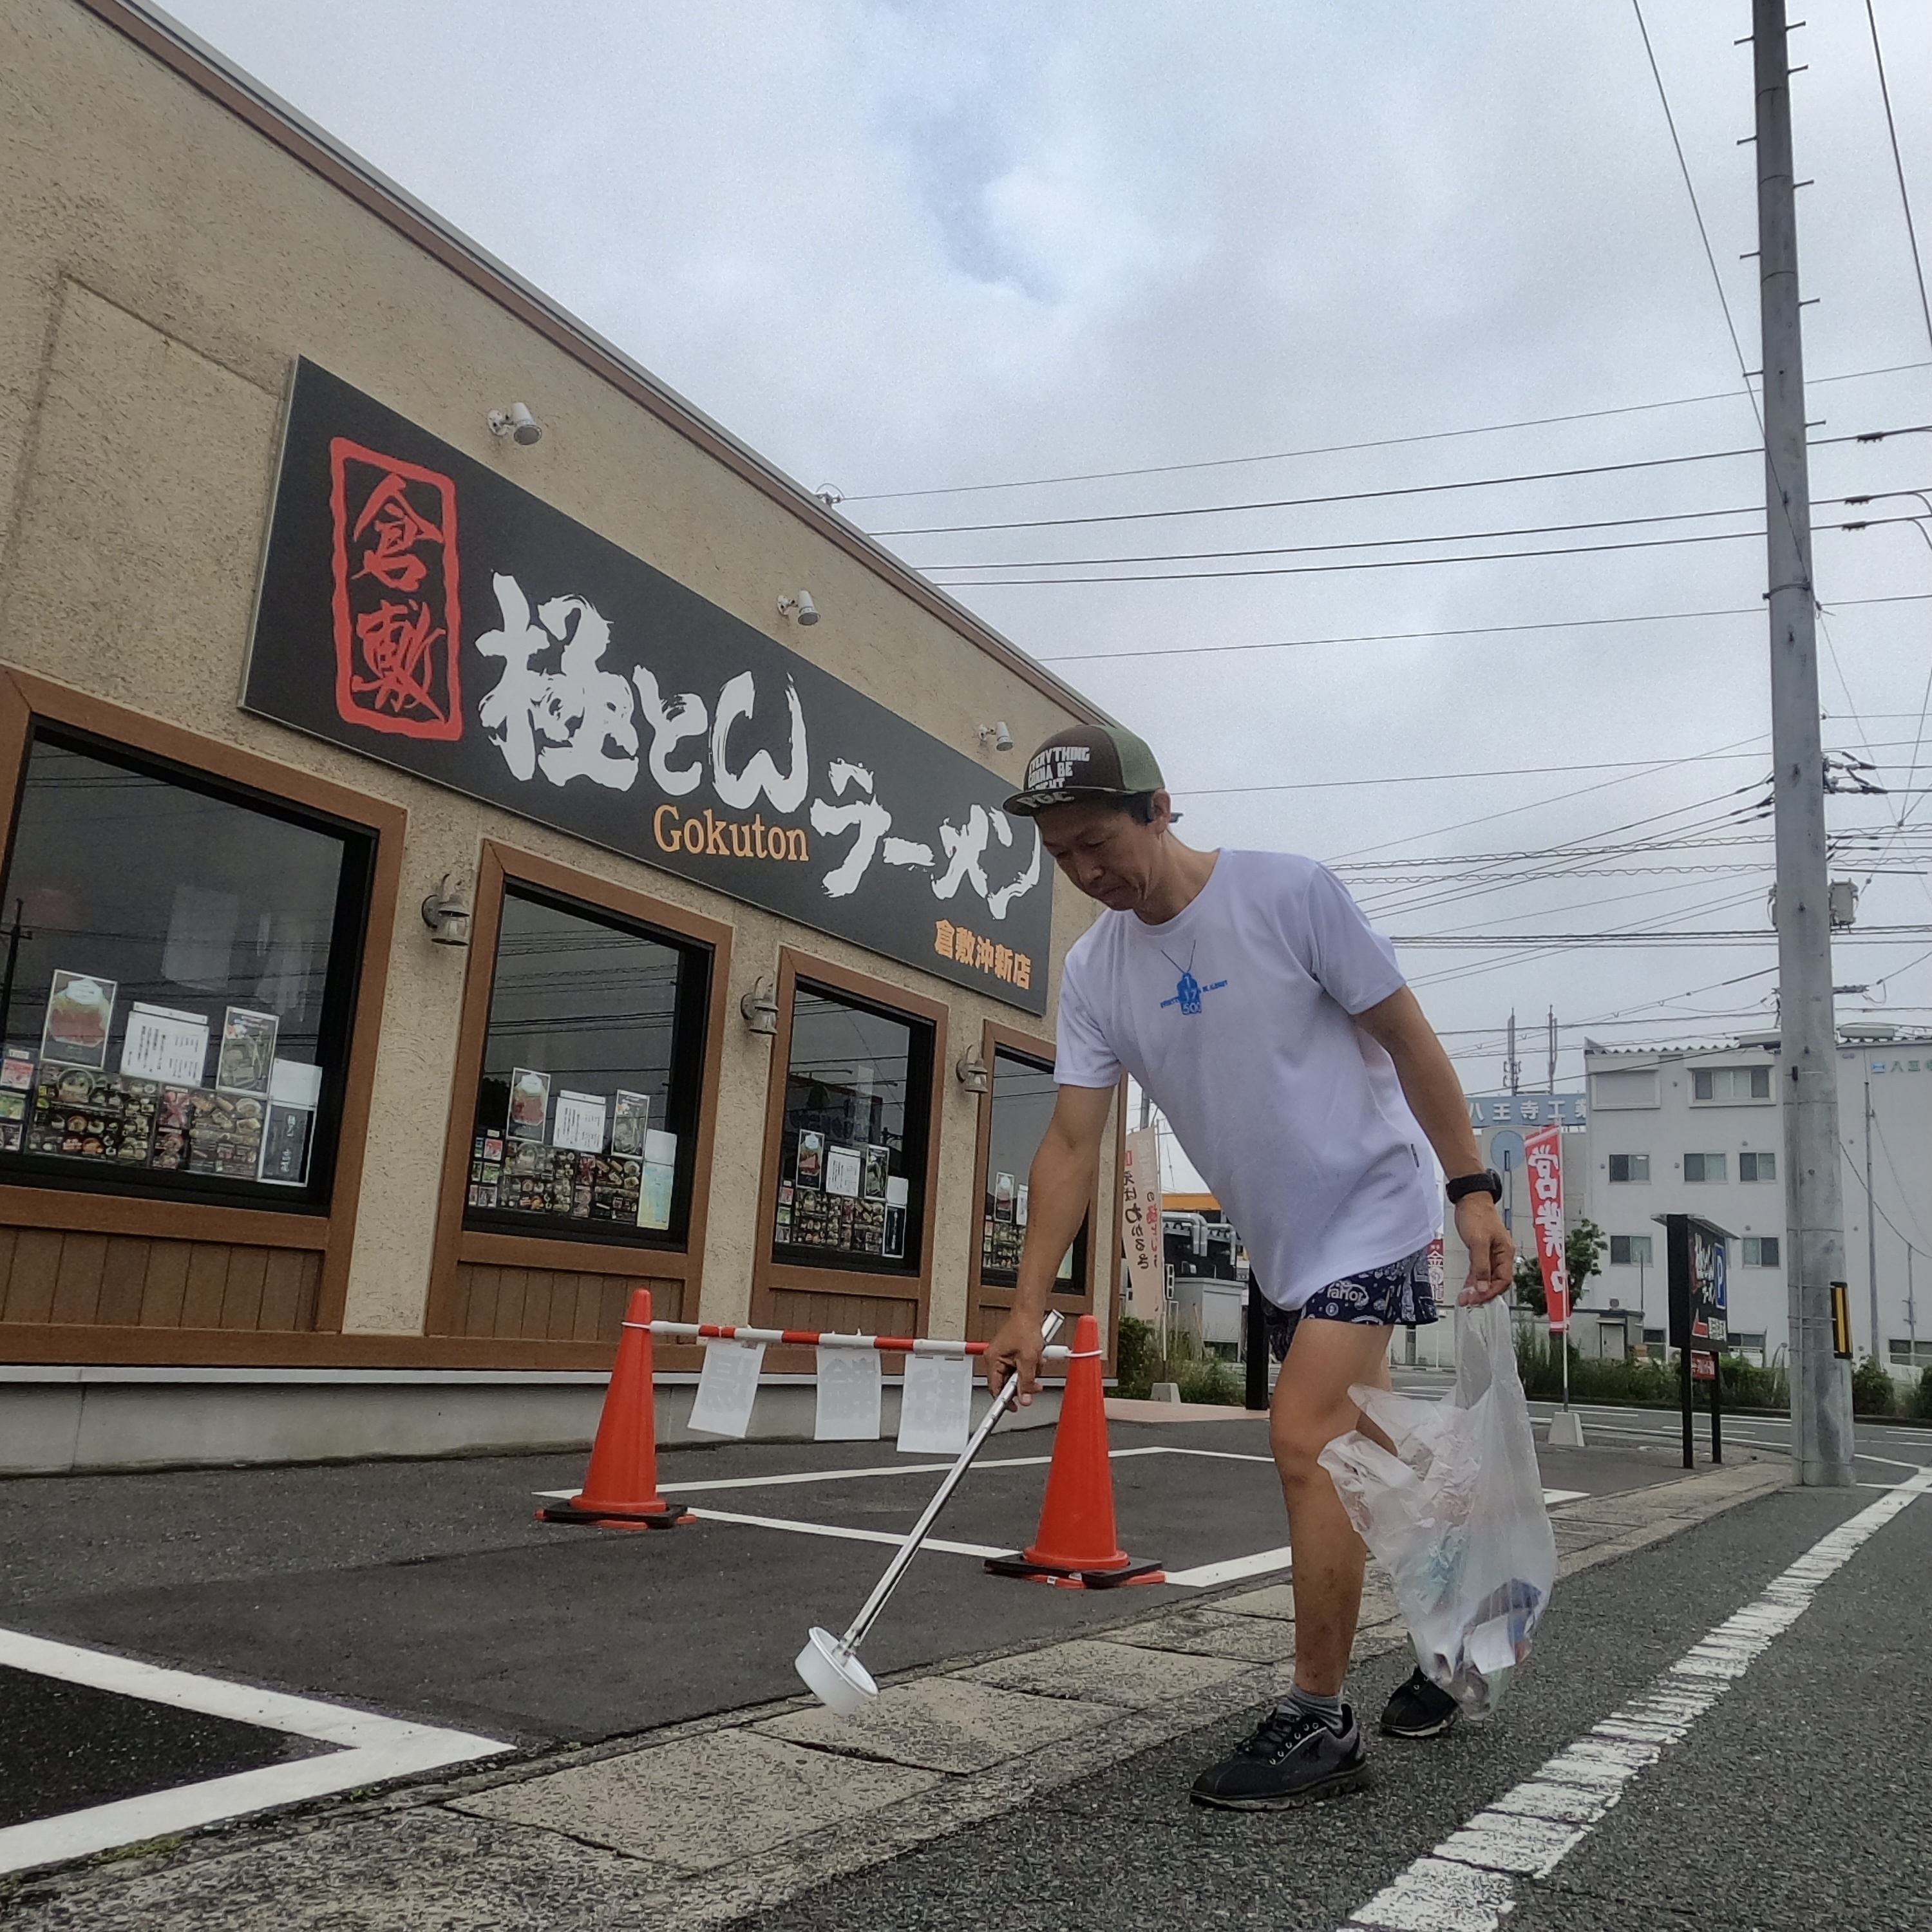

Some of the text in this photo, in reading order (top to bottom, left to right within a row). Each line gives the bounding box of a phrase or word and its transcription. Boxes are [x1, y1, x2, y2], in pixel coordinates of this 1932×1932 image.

[1057, 761, 1074, 778] BE
[653, 804, 810, 861] Gokuton
[934, 919, 1031, 990] 倉敷沖新店
[1717, 1255, 1723, 1298] P
